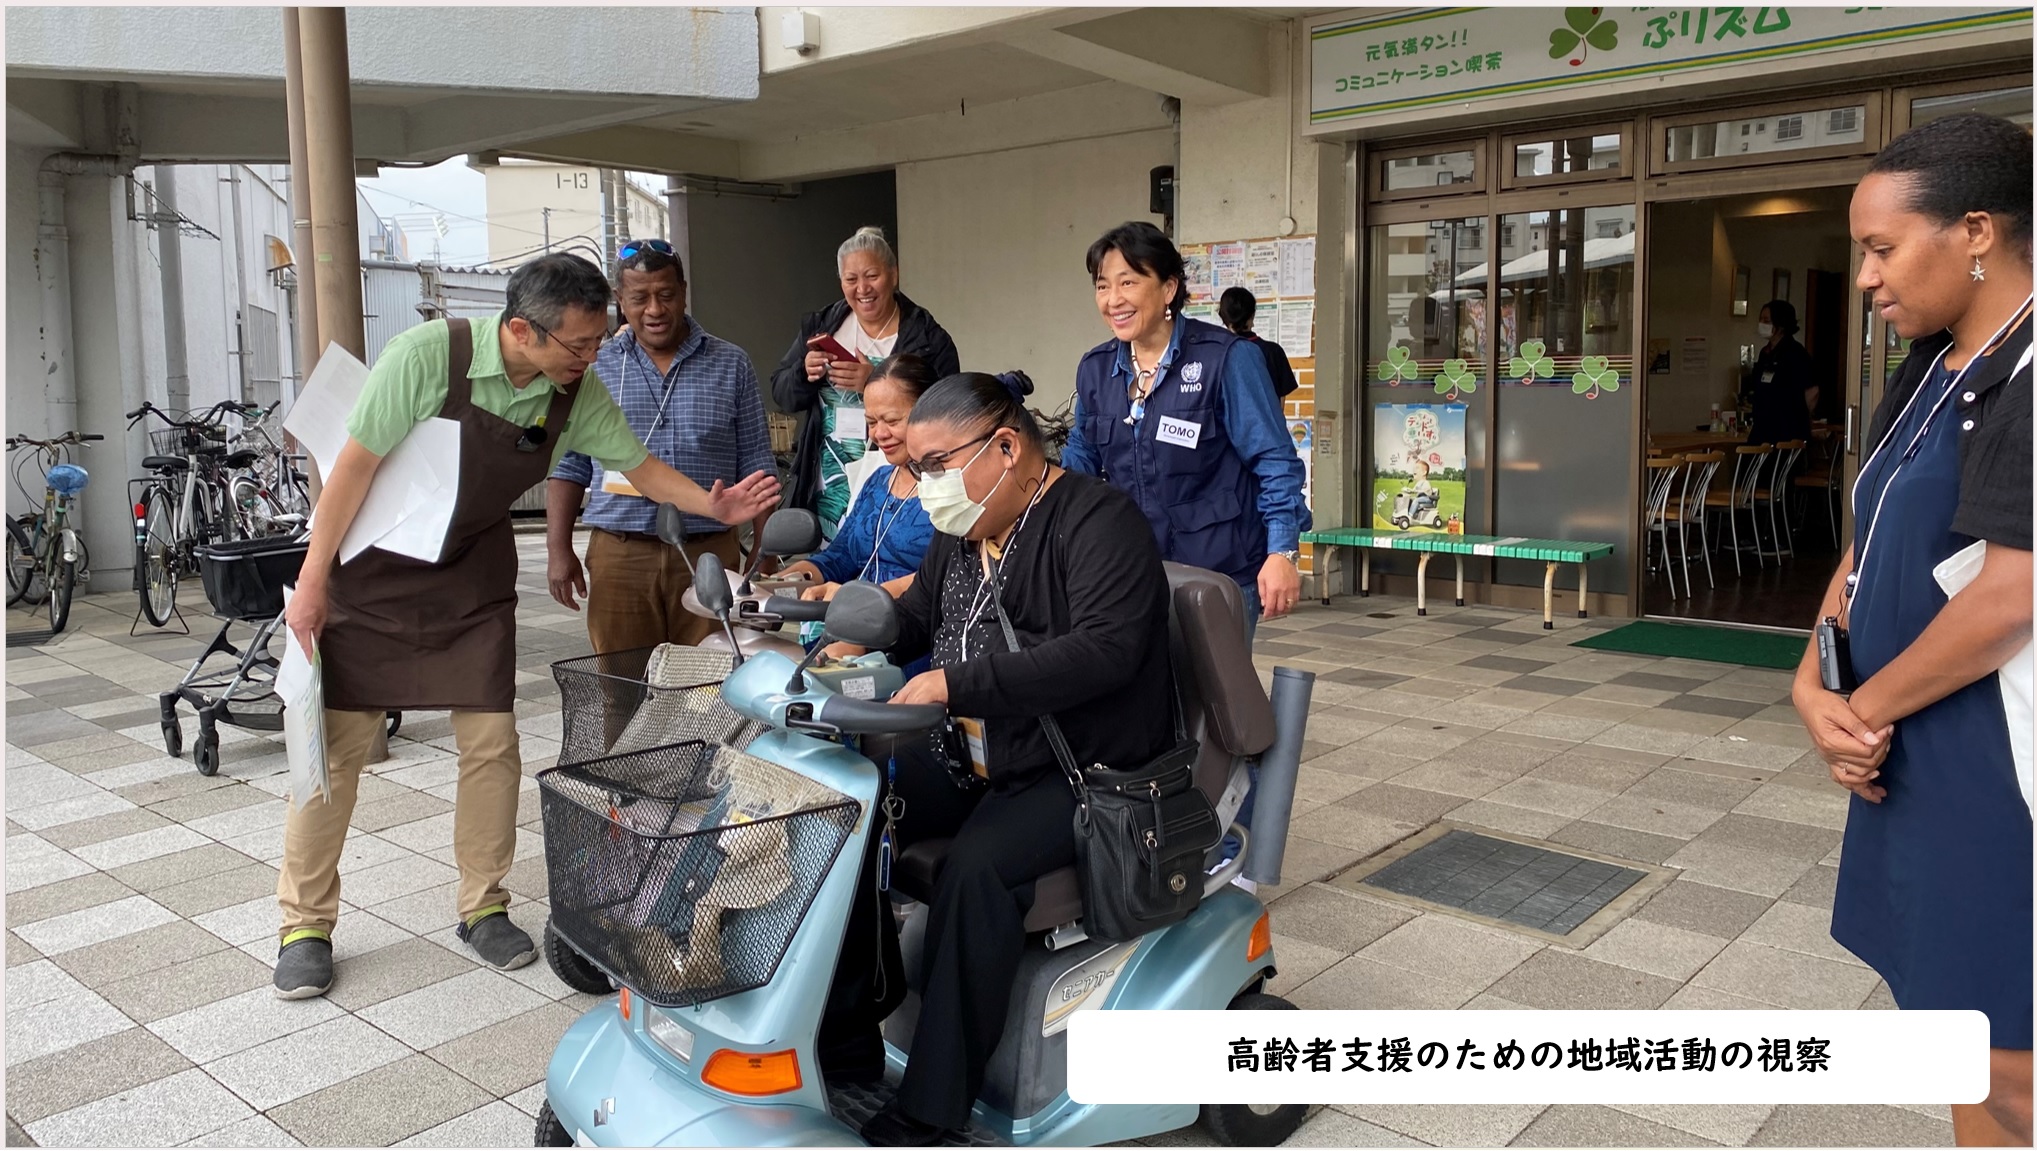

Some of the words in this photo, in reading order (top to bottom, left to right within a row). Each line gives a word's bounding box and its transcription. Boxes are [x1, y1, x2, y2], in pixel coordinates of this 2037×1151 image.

[1335, 51, 1503, 92] コミュニケーション喫茶
[557, 172, 588, 189] 1-13
[1180, 382, 1203, 393] WHO
[1162, 423, 1195, 438] TOMO
[1062, 970, 1115, 1001] セニアカー
